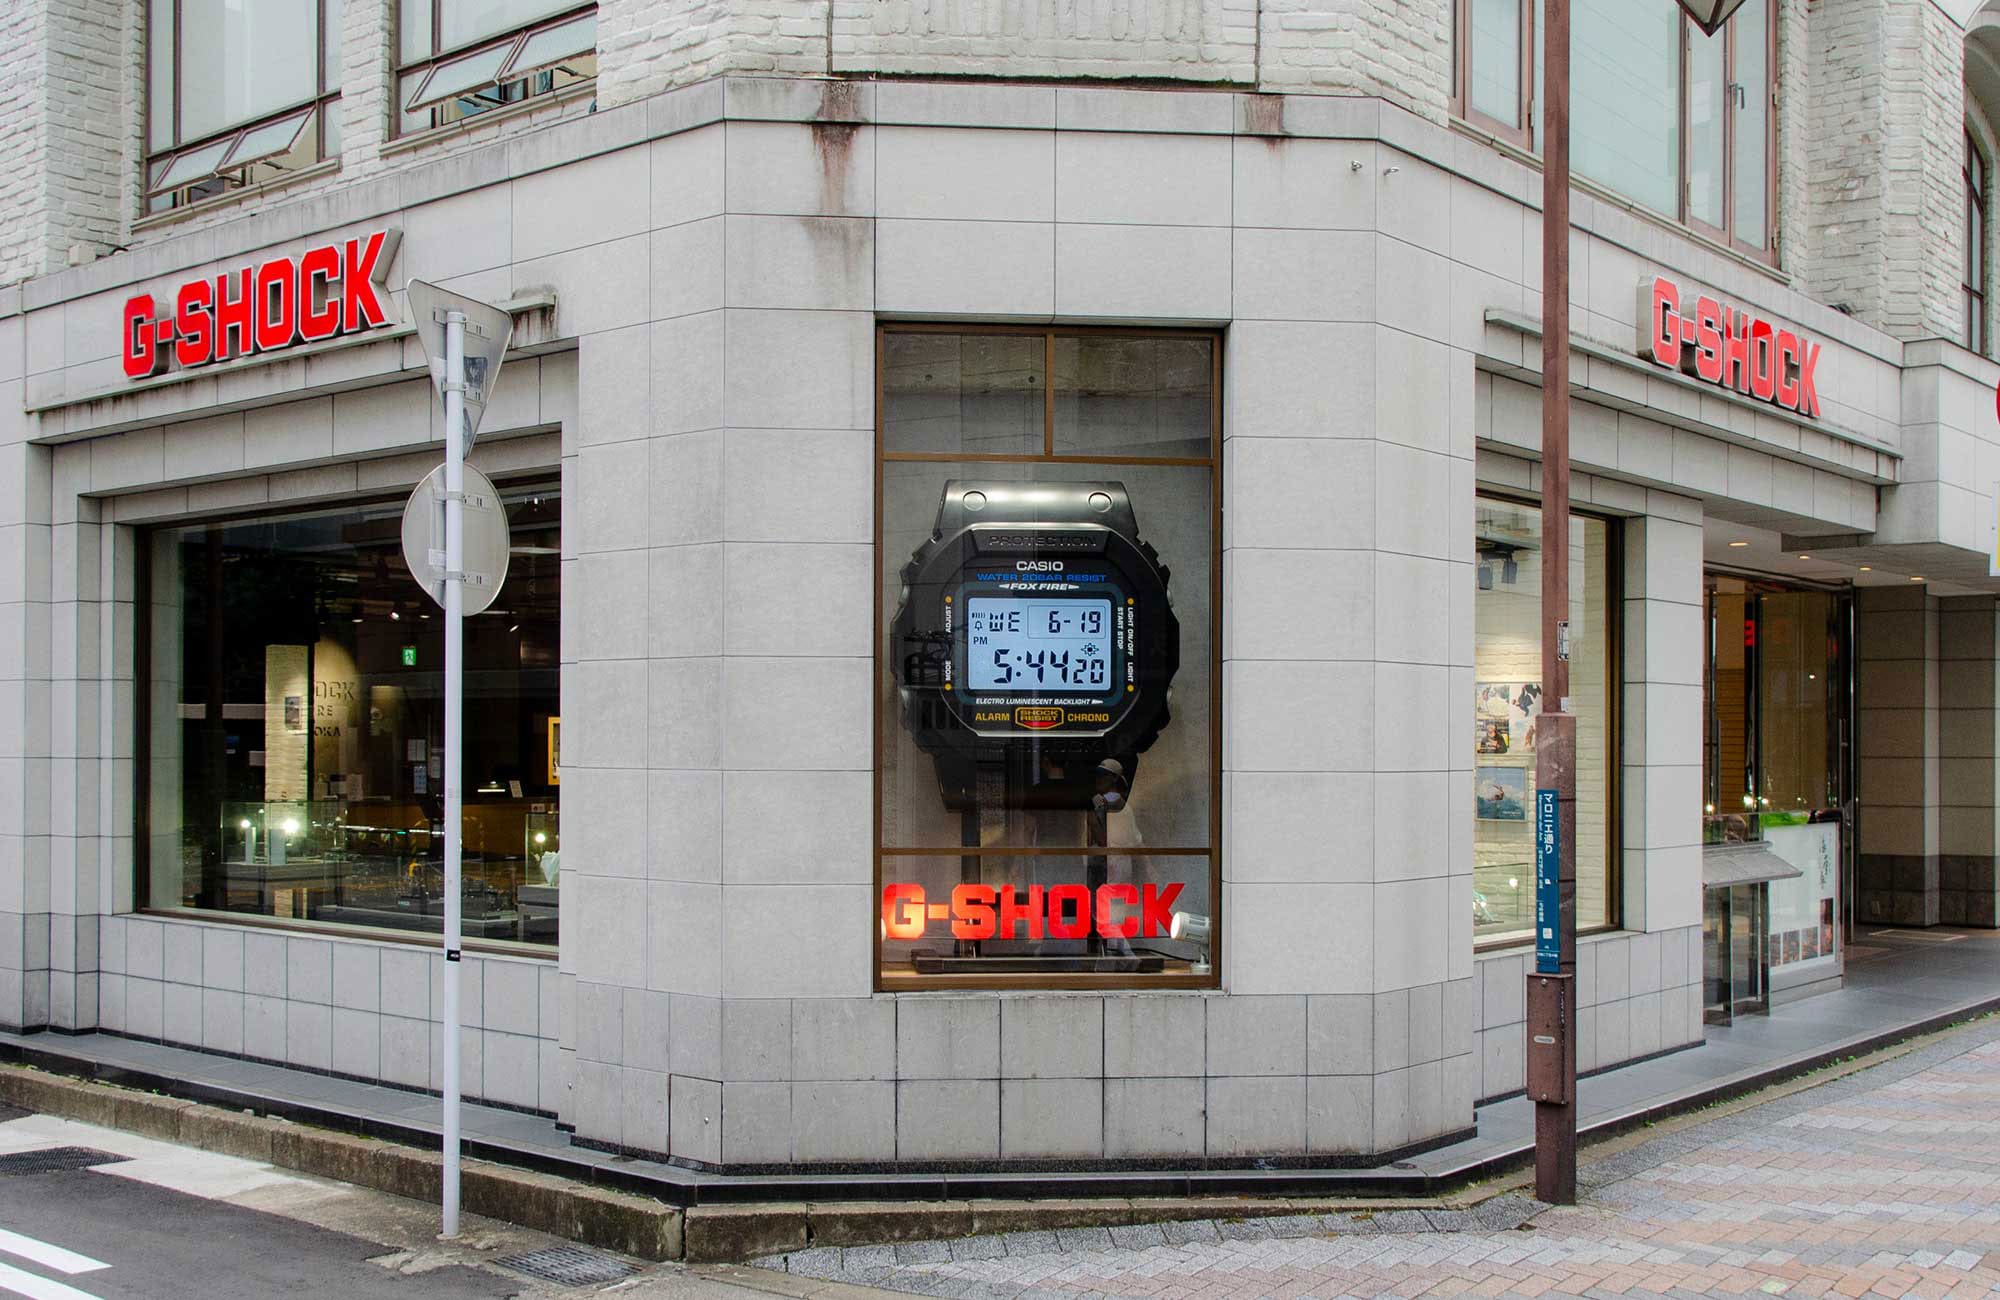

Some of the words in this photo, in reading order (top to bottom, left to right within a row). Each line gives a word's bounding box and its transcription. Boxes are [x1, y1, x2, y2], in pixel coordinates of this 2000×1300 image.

[123, 229, 398, 379] G-SHOCK
[1650, 275, 1822, 418] G-SHOCK
[989, 535, 1097, 547] PROTECTION
[1016, 561, 1064, 571] CASIO
[976, 573, 1018, 581] WATER
[1021, 573, 1063, 582] 20BAR
[1066, 574, 1107, 582] RESIST
[1039, 583, 1068, 591] FIRE
[989, 611, 1021, 632] WE
[1049, 611, 1101, 633] 6-19
[973, 636, 988, 645] PM
[993, 649, 1069, 683] 5:44
[1073, 659, 1104, 684] 20
[975, 712, 1010, 721] ALARM
[1067, 713, 1109, 722] CHRONO
[1543, 793, 1555, 855] マロニエ通り
[882, 882, 1185, 940] G-SHOCK
